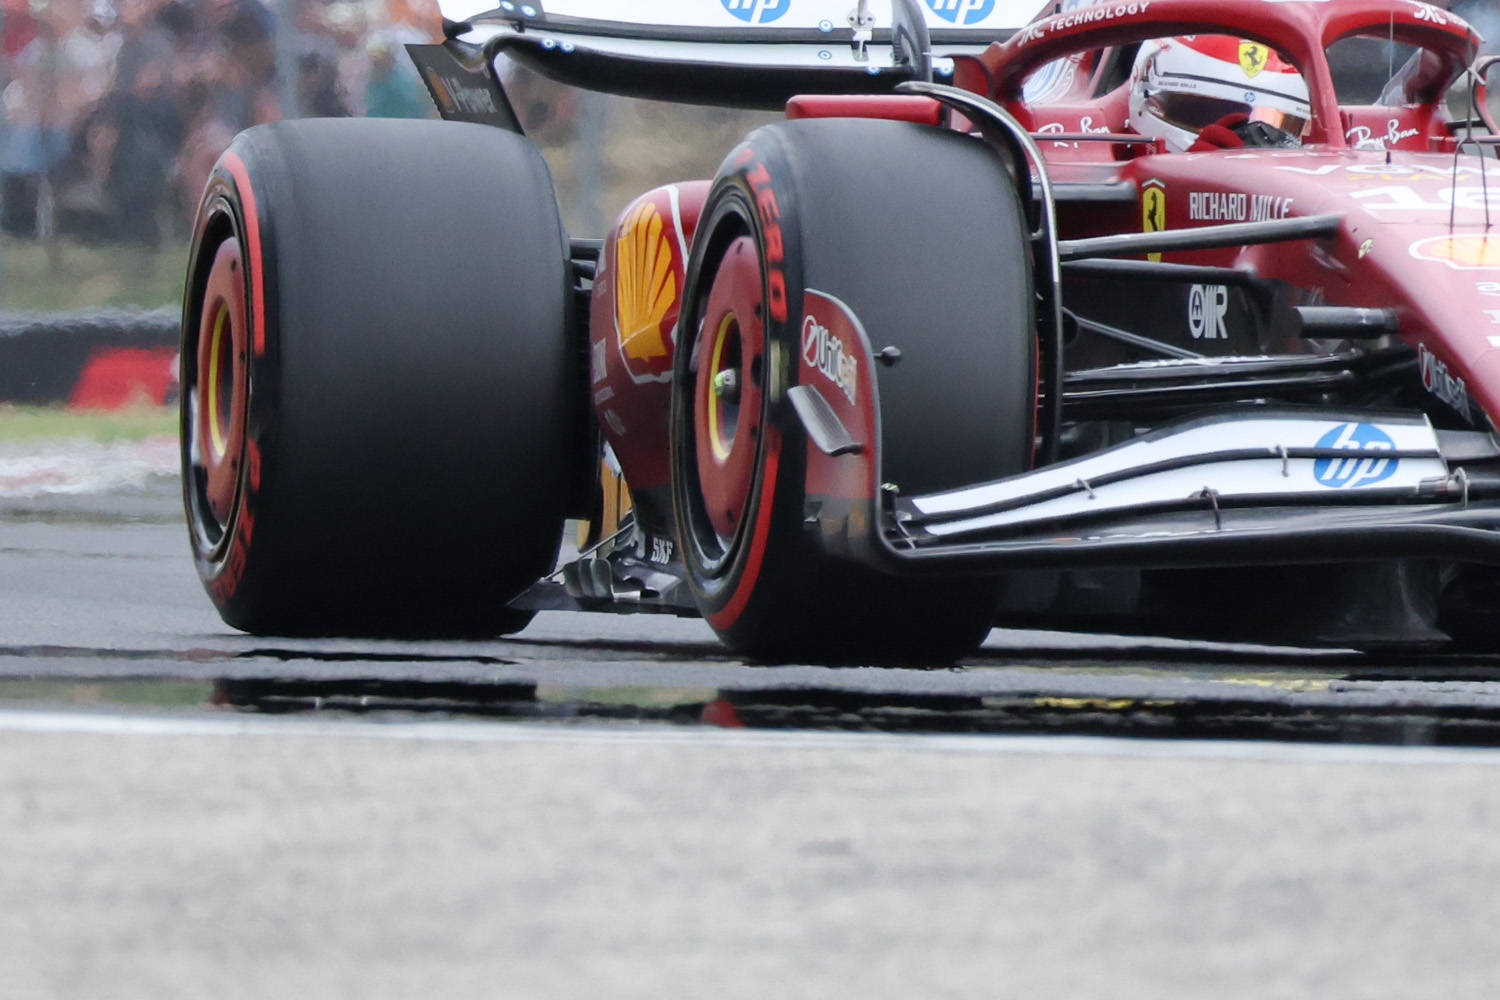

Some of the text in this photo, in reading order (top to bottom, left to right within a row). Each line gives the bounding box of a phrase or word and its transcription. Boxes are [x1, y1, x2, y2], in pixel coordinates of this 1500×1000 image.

[1049, 2, 1151, 32] TECHNOLOGY
[1189, 192, 1247, 221] RICHARD
[1320, 422, 1392, 488] hp
[651, 536, 673, 565] SKF
